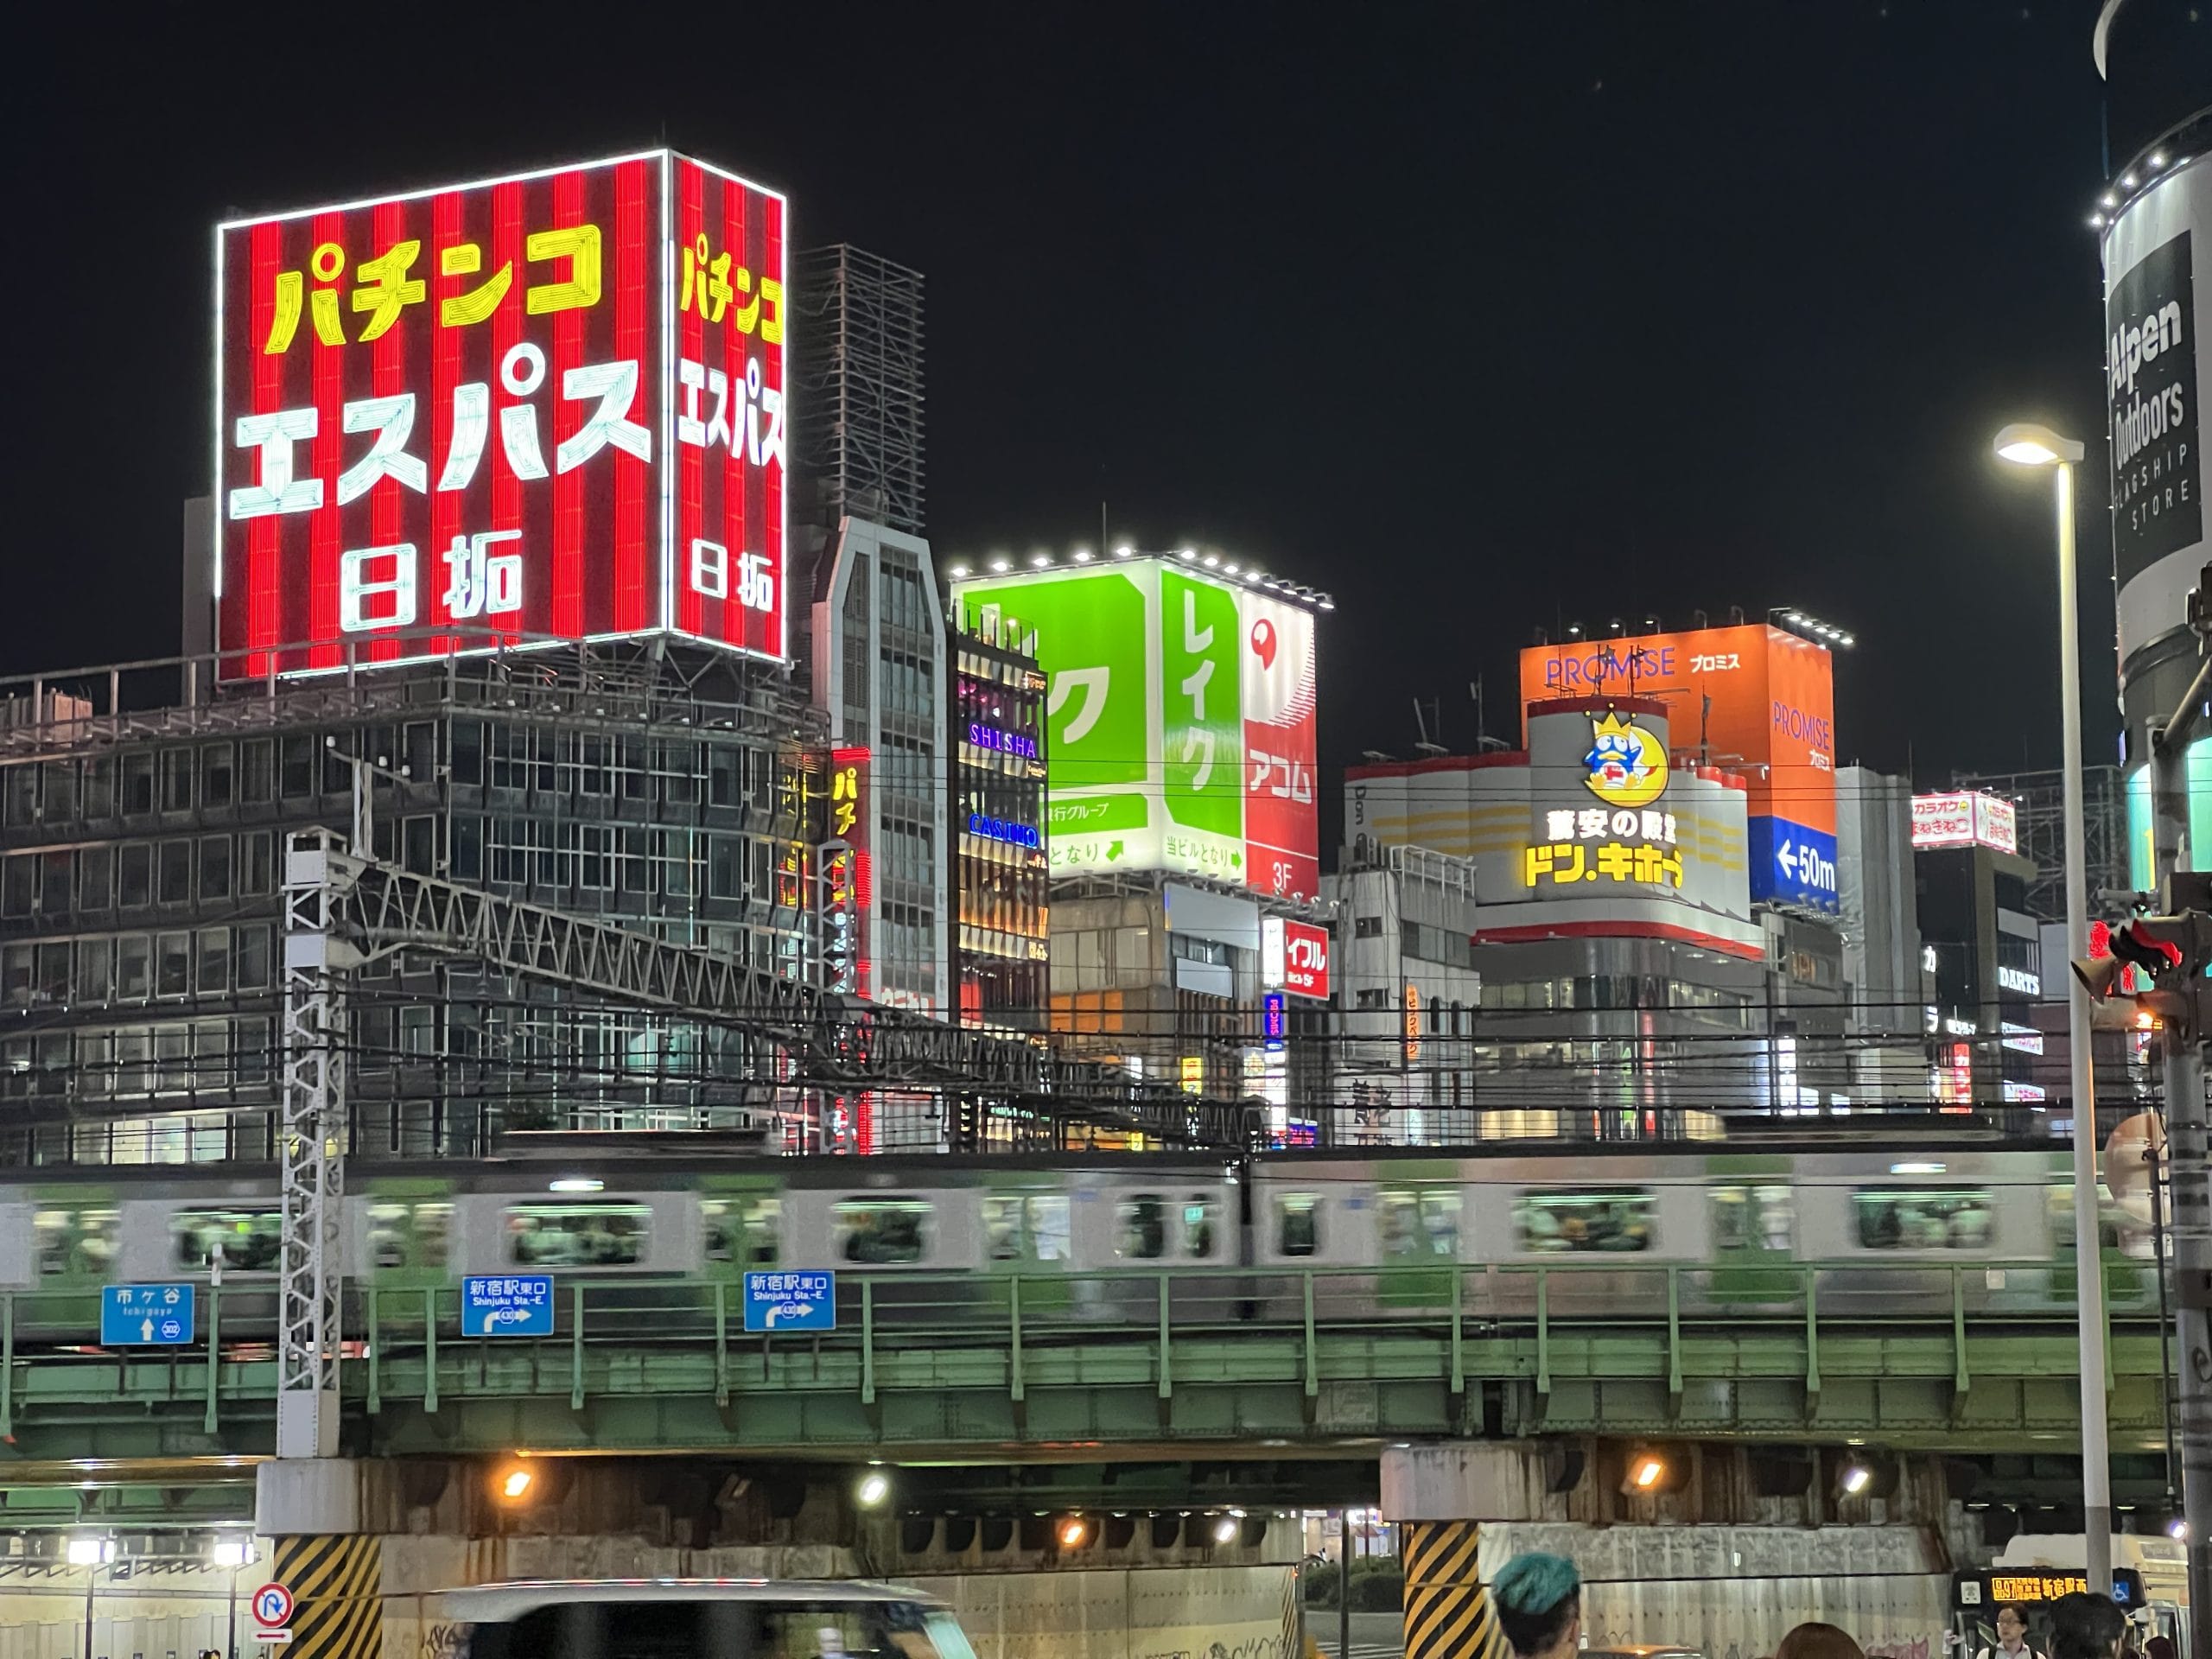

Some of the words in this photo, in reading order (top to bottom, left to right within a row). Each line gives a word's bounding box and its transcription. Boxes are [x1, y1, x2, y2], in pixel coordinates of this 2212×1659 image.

[264, 224, 601, 354] パチンコ
[680, 233, 785, 346] パチンコ
[2111, 300, 2182, 400] Alpen
[230, 343, 651, 519] エスパス
[677, 356, 785, 474] エスパス
[2116, 381, 2183, 470] Outdoors
[2115, 443, 2187, 512] FLAGSHIP
[2132, 479, 2190, 531] STORE
[340, 529, 522, 632] 日拓
[691, 538, 773, 612] 日拓
[1546, 647, 1675, 688] PROMISE
[1690, 654, 1740, 673] プロミス
[1182, 588, 1216, 791] レイク
[970, 723, 1036, 759] SHISHA
[1772, 701, 1830, 750] PROMISE
[1249, 748, 1313, 805] アコム
[1809, 750, 1829, 772] プロミス
[1547, 809, 1676, 844] 驚安の殿堂
[1914, 801, 1959, 814] カラオケ
[969, 814, 1038, 849] CASINO
[1050, 842, 1098, 866] となり
[1166, 836, 1228, 867] 当ビルとなり
[1799, 845, 1835, 892] 50m
[1273, 861, 1293, 889] 3F
[1286, 935, 1325, 971] イフル
[1999, 966, 2040, 995] DARTS
[470, 1280, 546, 1296] 新宿駅東口
[751, 1274, 827, 1291] 新宿駅東口
[753, 1291, 791, 1301] Shinjuku
[473, 1297, 511, 1307] Shinjuku
